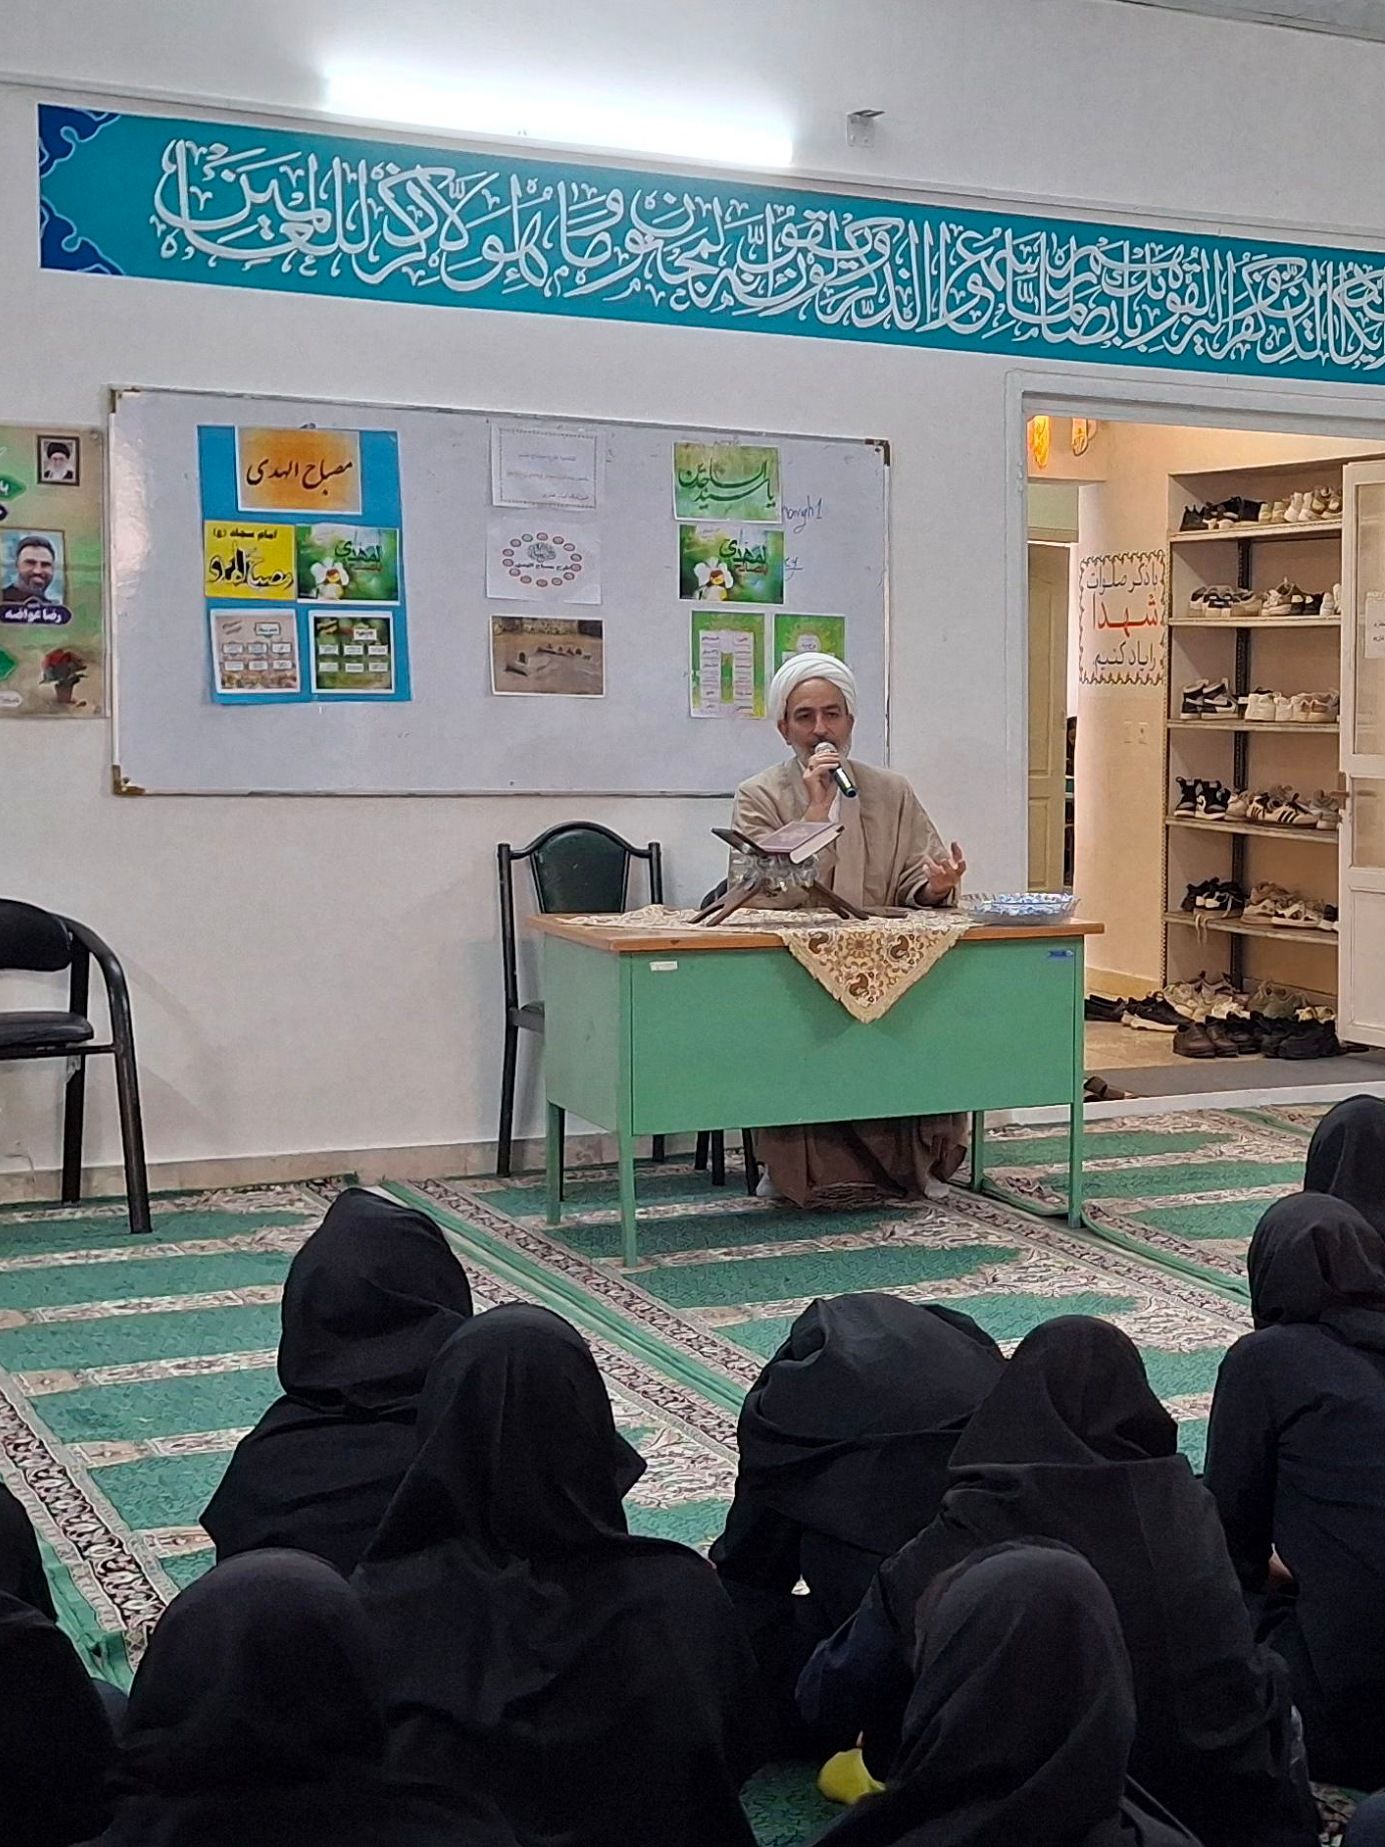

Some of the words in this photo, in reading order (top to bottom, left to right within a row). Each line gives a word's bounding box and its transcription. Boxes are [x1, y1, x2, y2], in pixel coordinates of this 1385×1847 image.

[302, 459, 353, 495] مصباح
[1087, 560, 1127, 595] صلوات
[1128, 563, 1149, 592] ذکر
[1092, 592, 1158, 637] شهدا
[1095, 641, 1126, 675] کنیم
[1128, 641, 1148, 671] یاد
